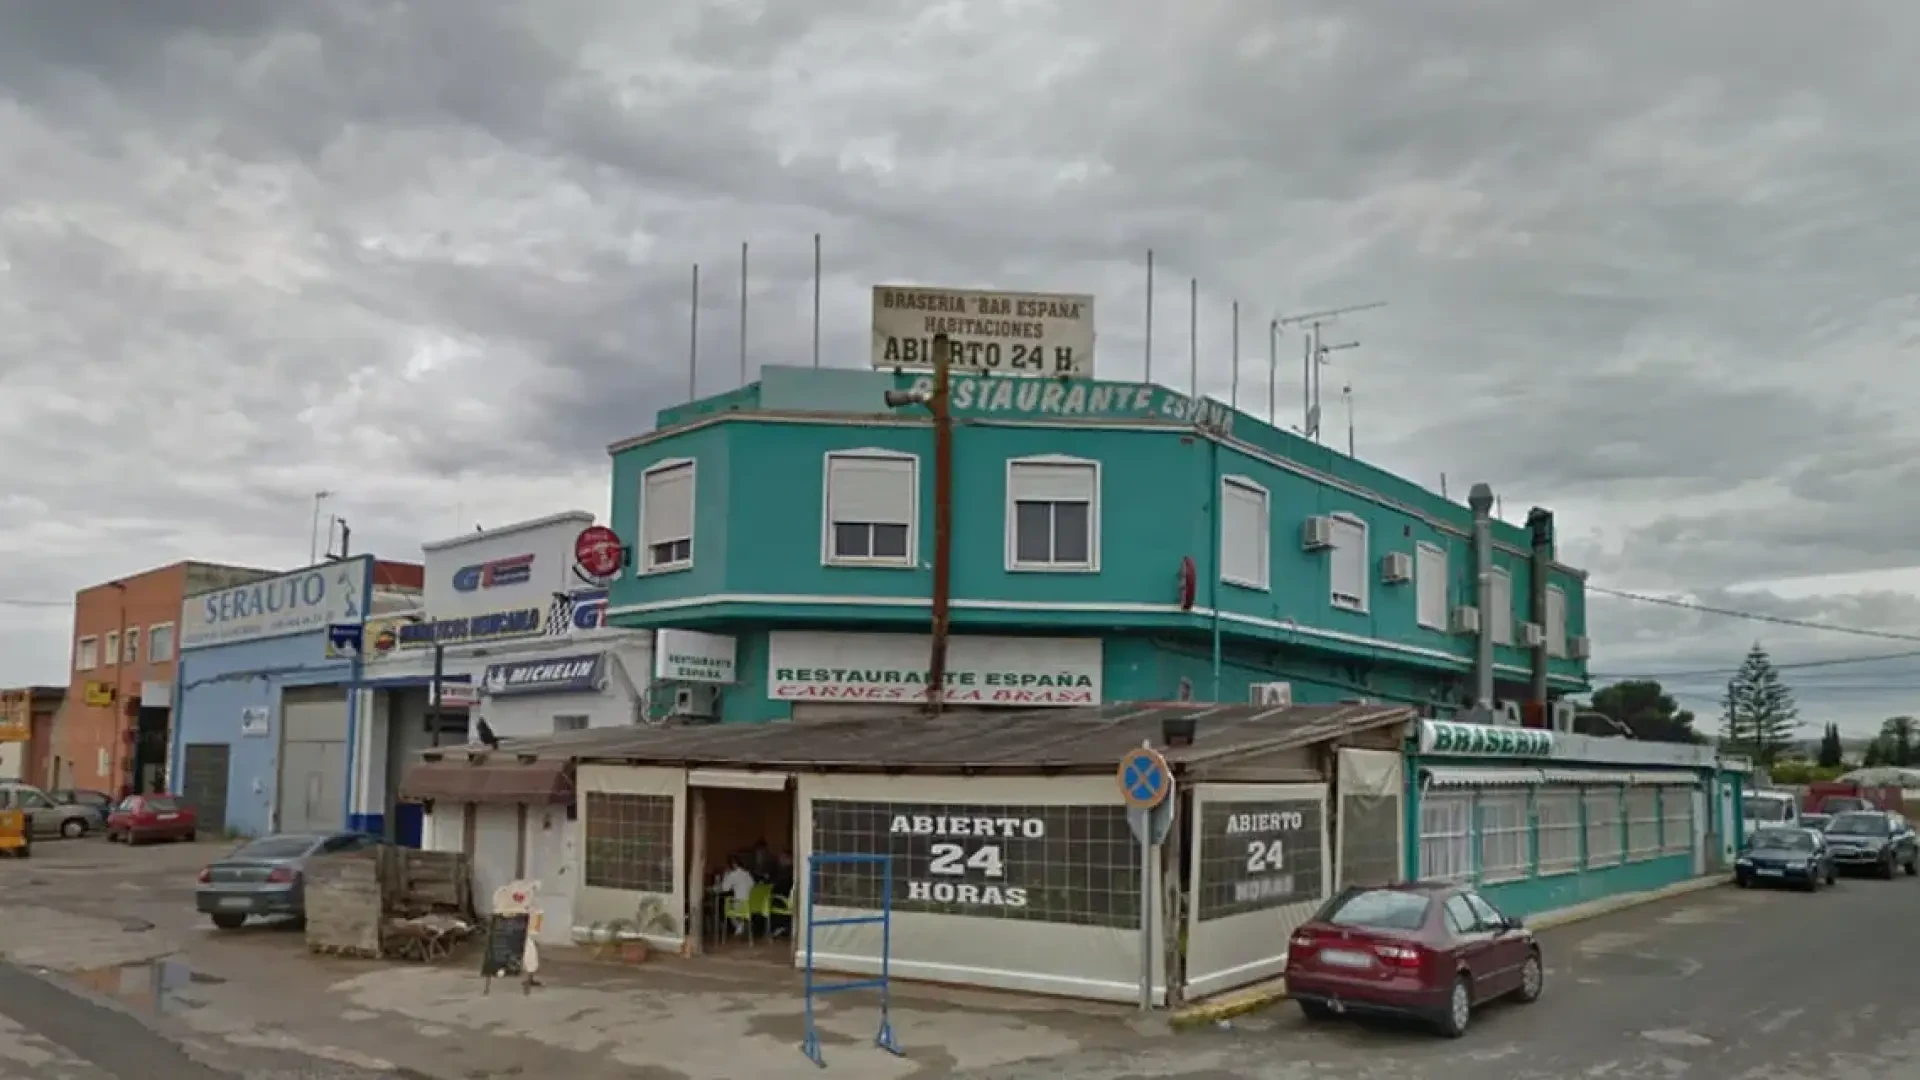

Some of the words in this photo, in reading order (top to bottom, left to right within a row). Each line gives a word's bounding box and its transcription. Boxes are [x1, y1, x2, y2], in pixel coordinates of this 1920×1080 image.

[883, 292, 966, 313] BRASERIA
[924, 316, 1044, 339] HABITACIONES
[883, 336, 1001, 367] ABIRTO
[1011, 344, 1044, 370] 24
[911, 377, 1154, 414] RSTAURANTE
[204, 572, 326, 624] SERAUTO
[509, 659, 596, 684] MICHELIN
[776, 668, 977, 686] RESTAURATE
[984, 670, 1093, 688] ESPAÑA
[777, 684, 905, 699] CARNES
[945, 688, 982, 701] LA
[991, 688, 1093, 703] BRASA
[1433, 723, 1550, 755] BRASERIA
[890, 814, 1045, 838] ABIERTO
[1226, 811, 1302, 834] ABIERTO
[929, 843, 1003, 877] 24
[1246, 840, 1283, 872] 24
[907, 881, 1028, 907] HORAS
